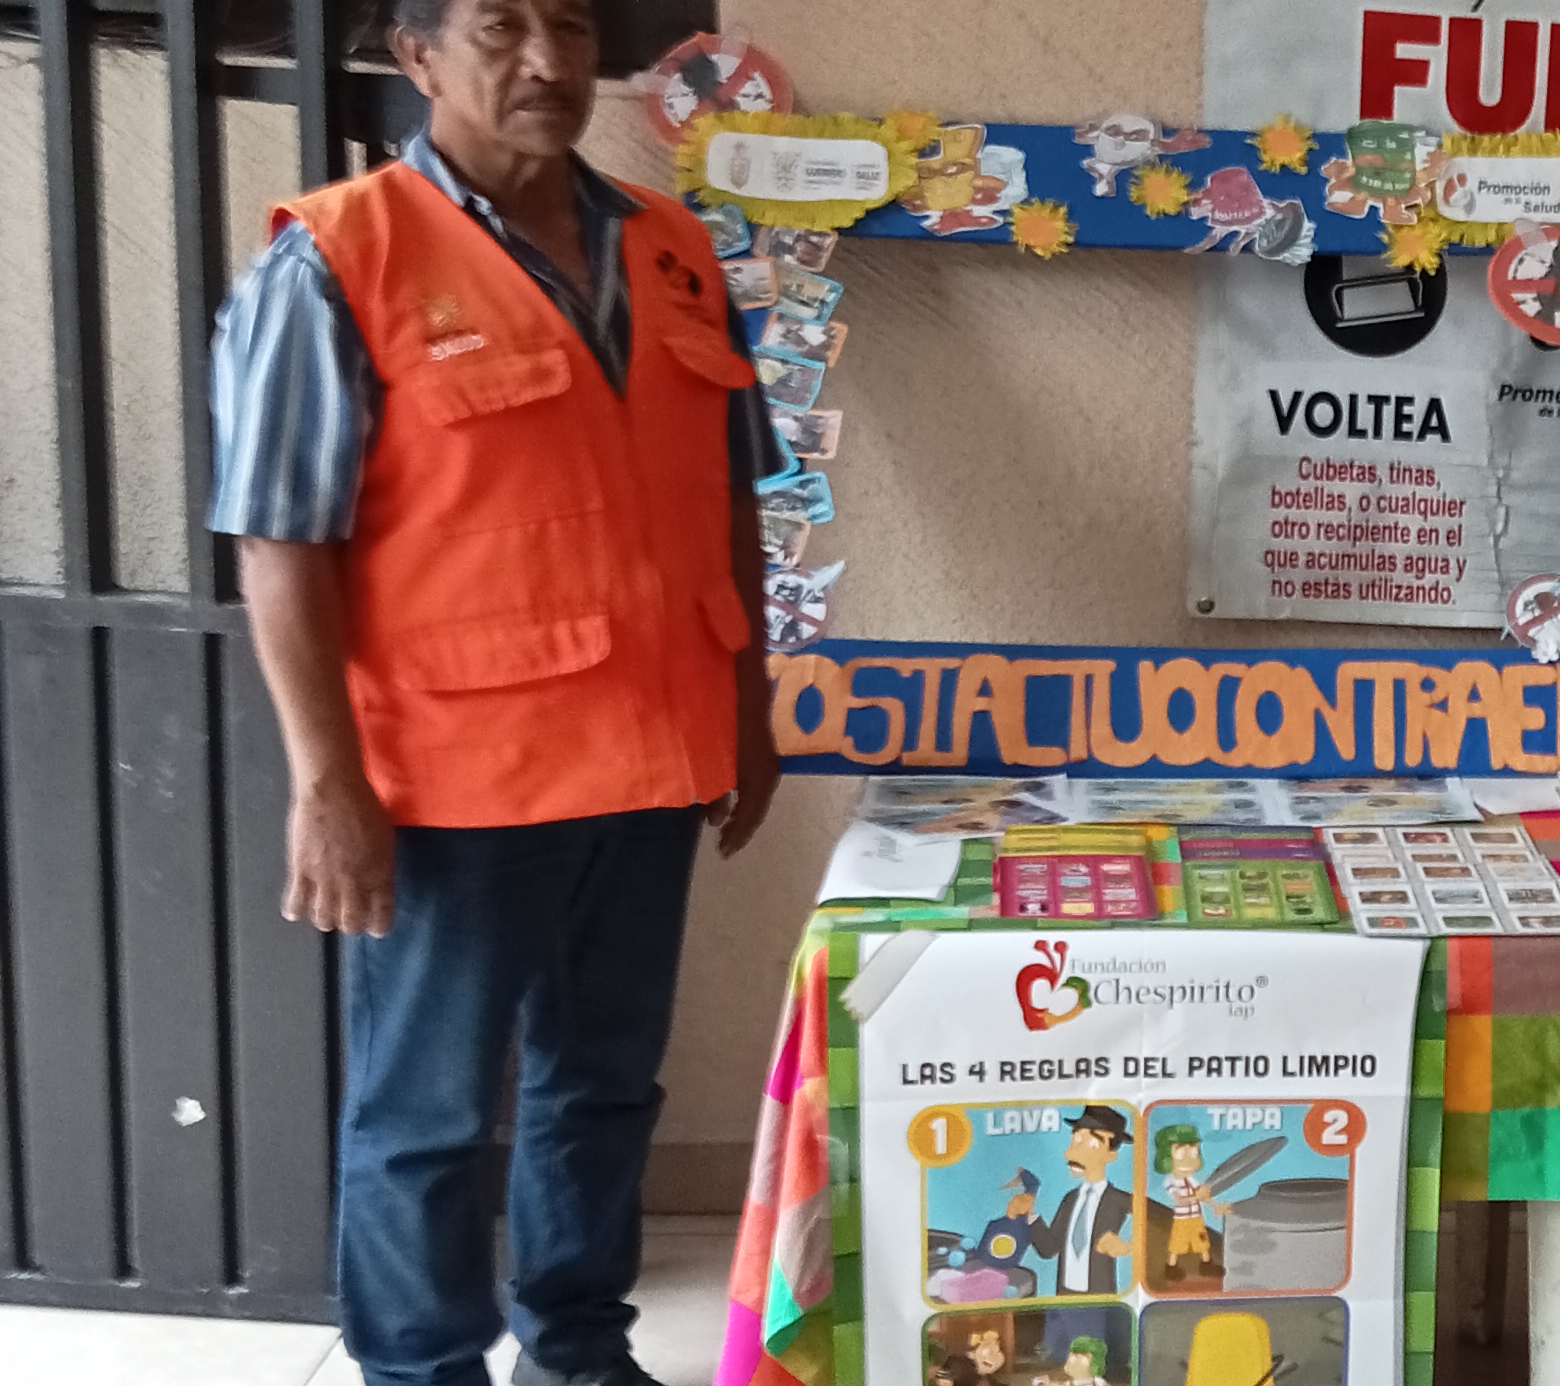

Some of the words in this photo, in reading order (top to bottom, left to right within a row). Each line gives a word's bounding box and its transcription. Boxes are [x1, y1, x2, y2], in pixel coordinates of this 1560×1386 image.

[1478, 178, 1550, 196] Promoción
[1268, 389, 1452, 444] VOLTEA
[1298, 456, 1383, 487] Cubetas,
[1389, 461, 1441, 490] tinas,
[1270, 485, 1353, 514] botellas,
[1359, 494, 1371, 512] o
[1377, 492, 1467, 522] cualquier
[1271, 516, 1311, 540] otro
[1316, 518, 1411, 548] recipiente
[1416, 526, 1440, 545] en
[1446, 524, 1463, 547] el
[1263, 550, 1299, 574] que
[1306, 549, 1398, 573] acumulas
[1403, 555, 1451, 580] agua
[1456, 557, 1467, 583] y
[1271, 579, 1296, 598] no
[1358, 578, 1457, 605] utilizando.
[1069, 957, 1167, 974] Fundación
[901, 1062, 957, 1086] LAS
[968, 1061, 987, 1082] 4
[1000, 1056, 1111, 1083] REGLAS
[1123, 1056, 1175, 1079] DEL
[1187, 1054, 1271, 1078] PATIO
[1282, 1053, 1378, 1078] LIMPIO
[985, 1108, 1060, 1135] LAVA
[1207, 1107, 1282, 1131] TAPA
[1321, 1110, 1350, 1145] 2
[928, 1117, 948, 1155] 1
